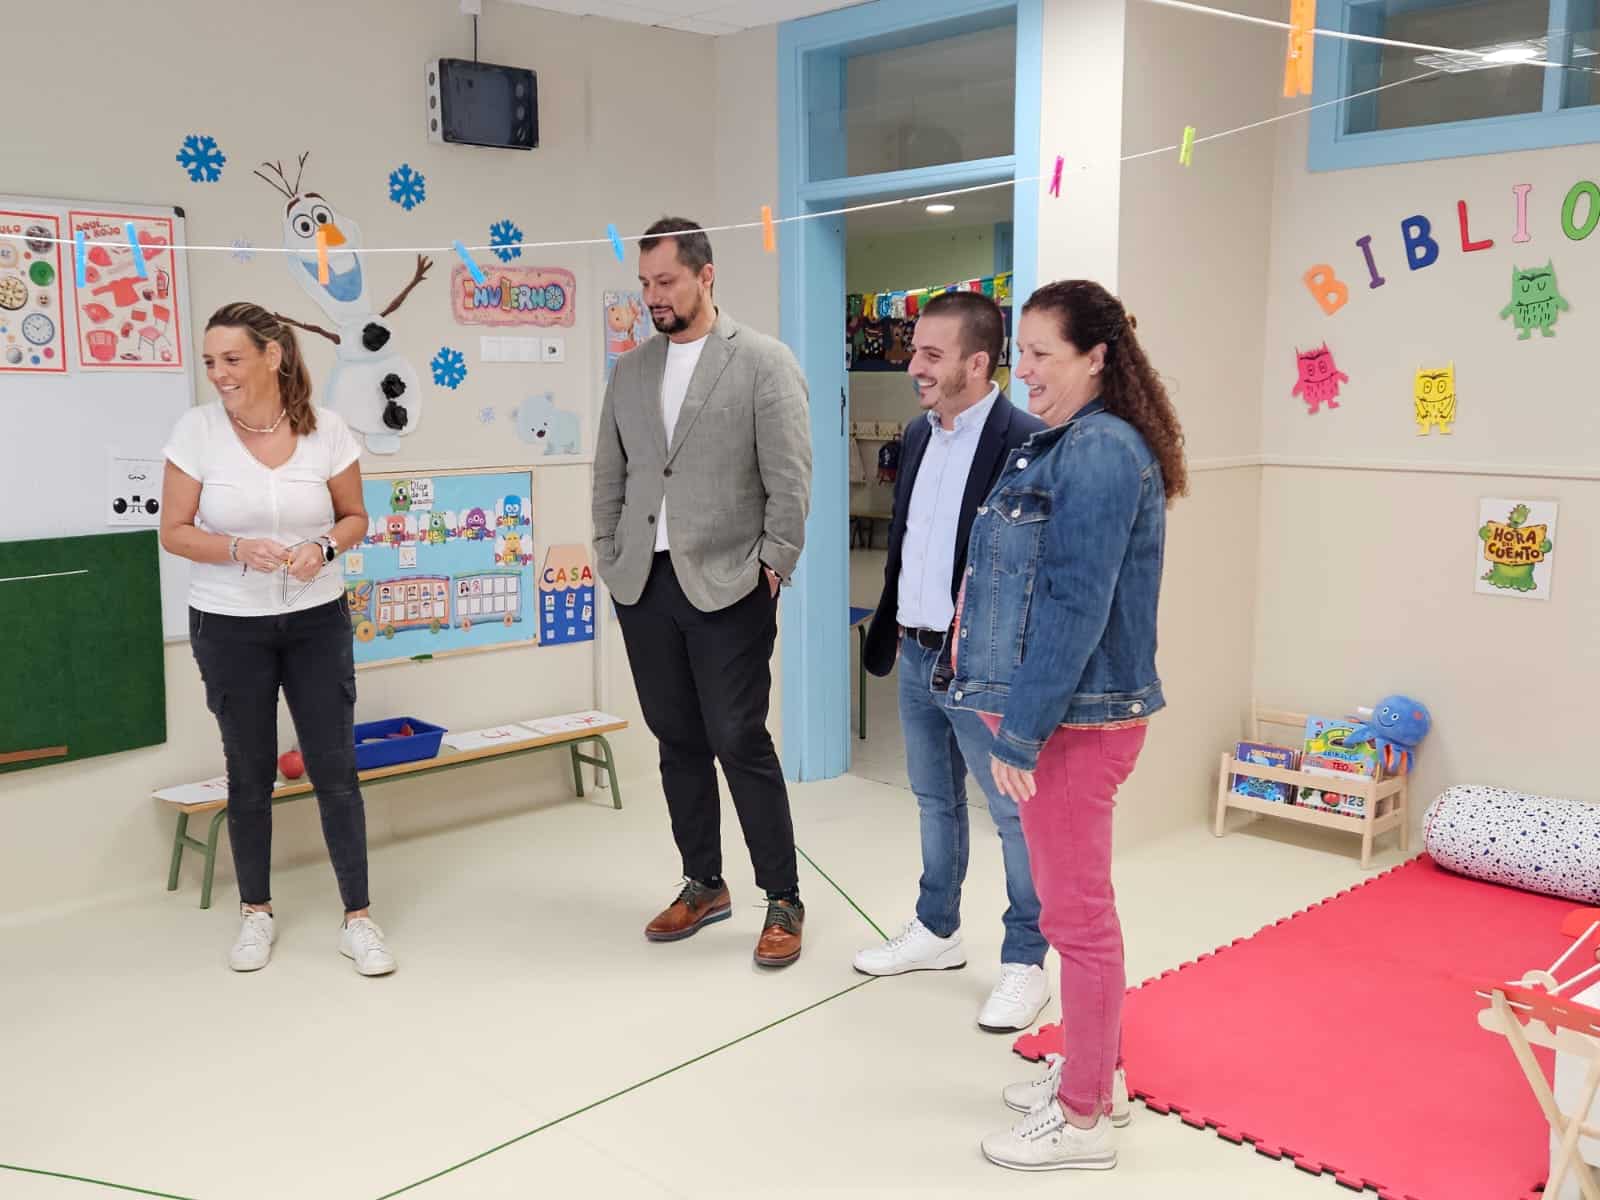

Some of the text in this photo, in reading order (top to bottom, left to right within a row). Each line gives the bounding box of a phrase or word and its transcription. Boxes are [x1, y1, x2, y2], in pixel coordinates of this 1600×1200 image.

[1303, 180, 1600, 316] BIBLIO
[463, 276, 565, 312] INVIERNO
[1493, 527, 1537, 545] HORA
[1488, 543, 1540, 561] CUENTO
[543, 566, 592, 584] CASA
[1343, 793, 1365, 808] 123
